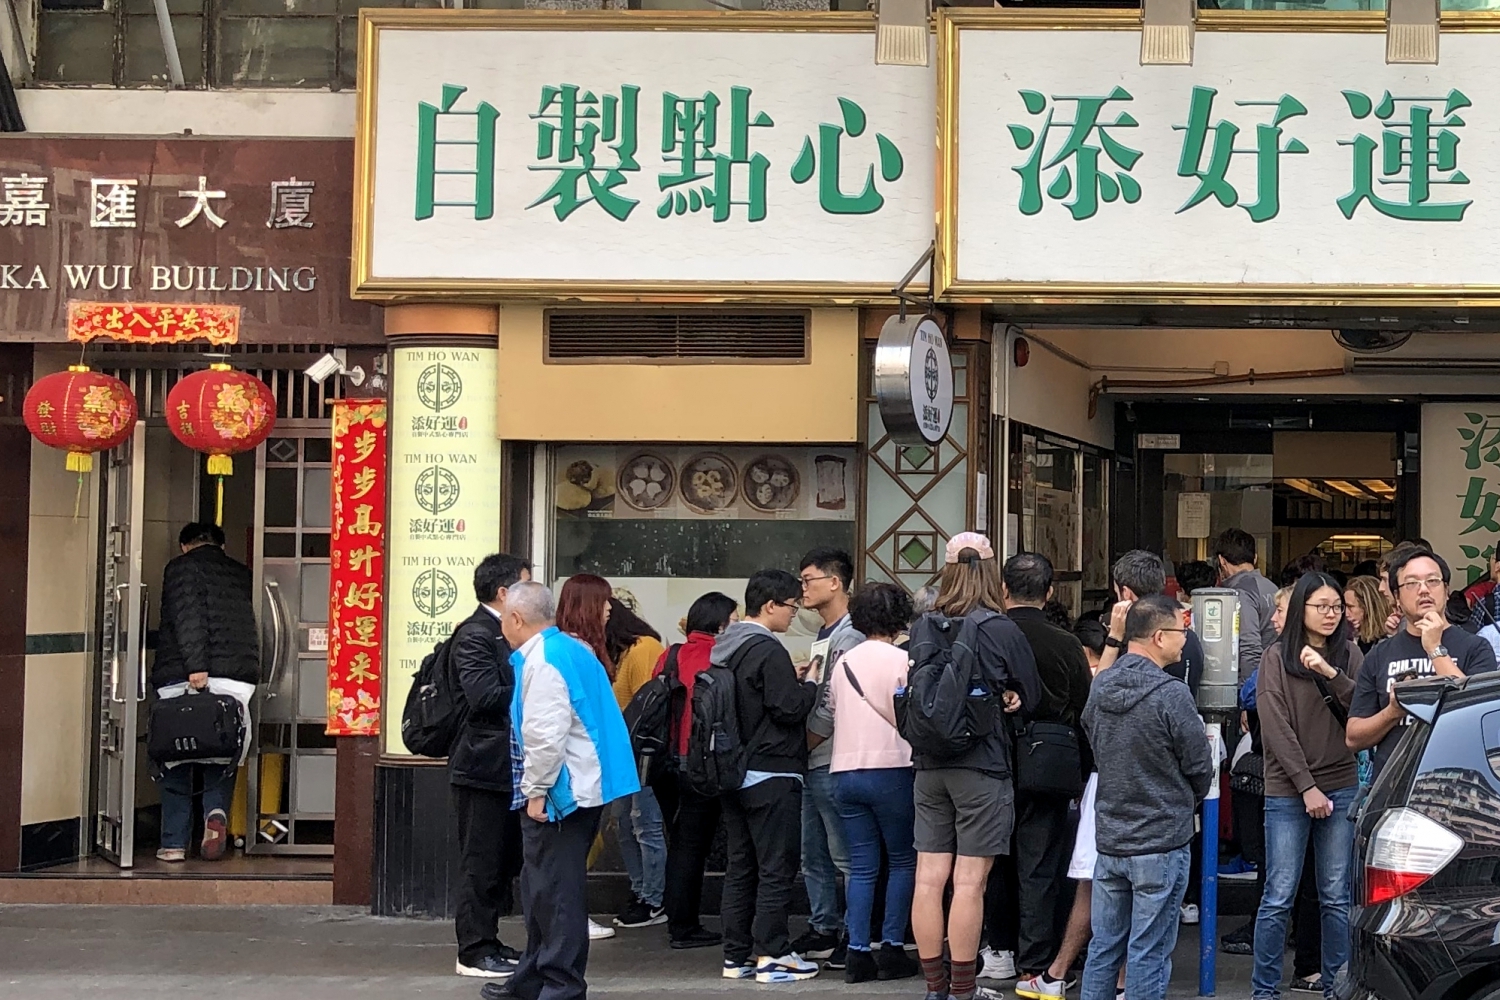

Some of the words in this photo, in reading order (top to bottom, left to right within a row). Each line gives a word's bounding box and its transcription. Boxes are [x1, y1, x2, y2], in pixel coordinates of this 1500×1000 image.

[414, 82, 904, 223] 自製點心
[0, 173, 316, 229] 嘉匯大廈
[0, 265, 49, 290] KA
[63, 265, 133, 290] WUI
[150, 266, 317, 292] BUILDING
[105, 308, 202, 335] 出入平安
[407, 352, 423, 361] TIM
[428, 351, 446, 361] HO
[451, 352, 480, 361] WAN
[411, 416, 458, 431] 添好運
[404, 454, 421, 463] TIM
[425, 454, 444, 463] HO
[448, 454, 477, 463] WAN
[409, 518, 455, 533] 添好運
[402, 556, 418, 566] TIM
[423, 556, 442, 566] HO
[446, 556, 475, 566] WAN
[407, 622, 453, 637] 添好運
[400, 659, 417, 669] TIM
